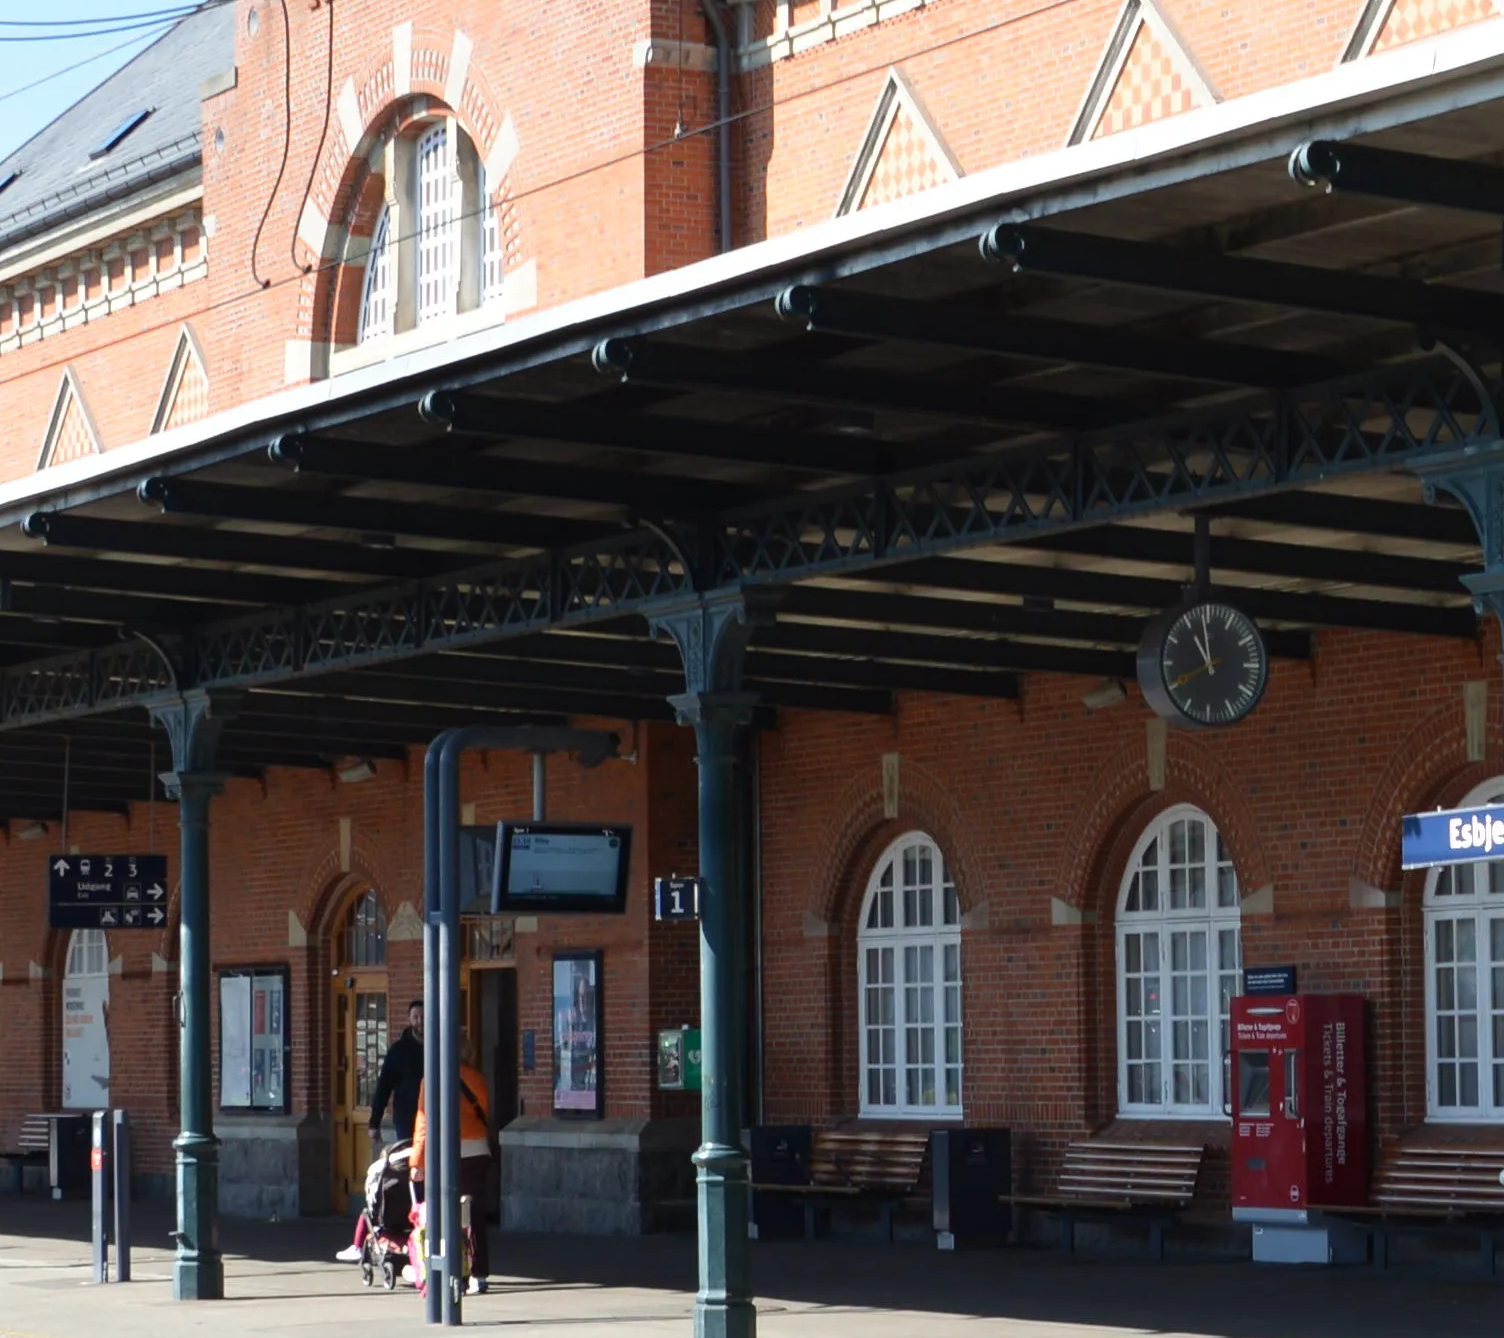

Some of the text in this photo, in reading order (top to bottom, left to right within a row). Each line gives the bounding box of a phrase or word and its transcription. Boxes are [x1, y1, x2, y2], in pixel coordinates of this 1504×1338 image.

[104, 863, 138, 877] 2 3
[670, 890, 684, 913] 1
[1323, 1022, 1333, 1067] Tickets
[1324, 1070, 1333, 1079] &
[1324, 1084, 1333, 1113] Train
[1336, 1022, 1347, 1165] Billetter & Togafgange
